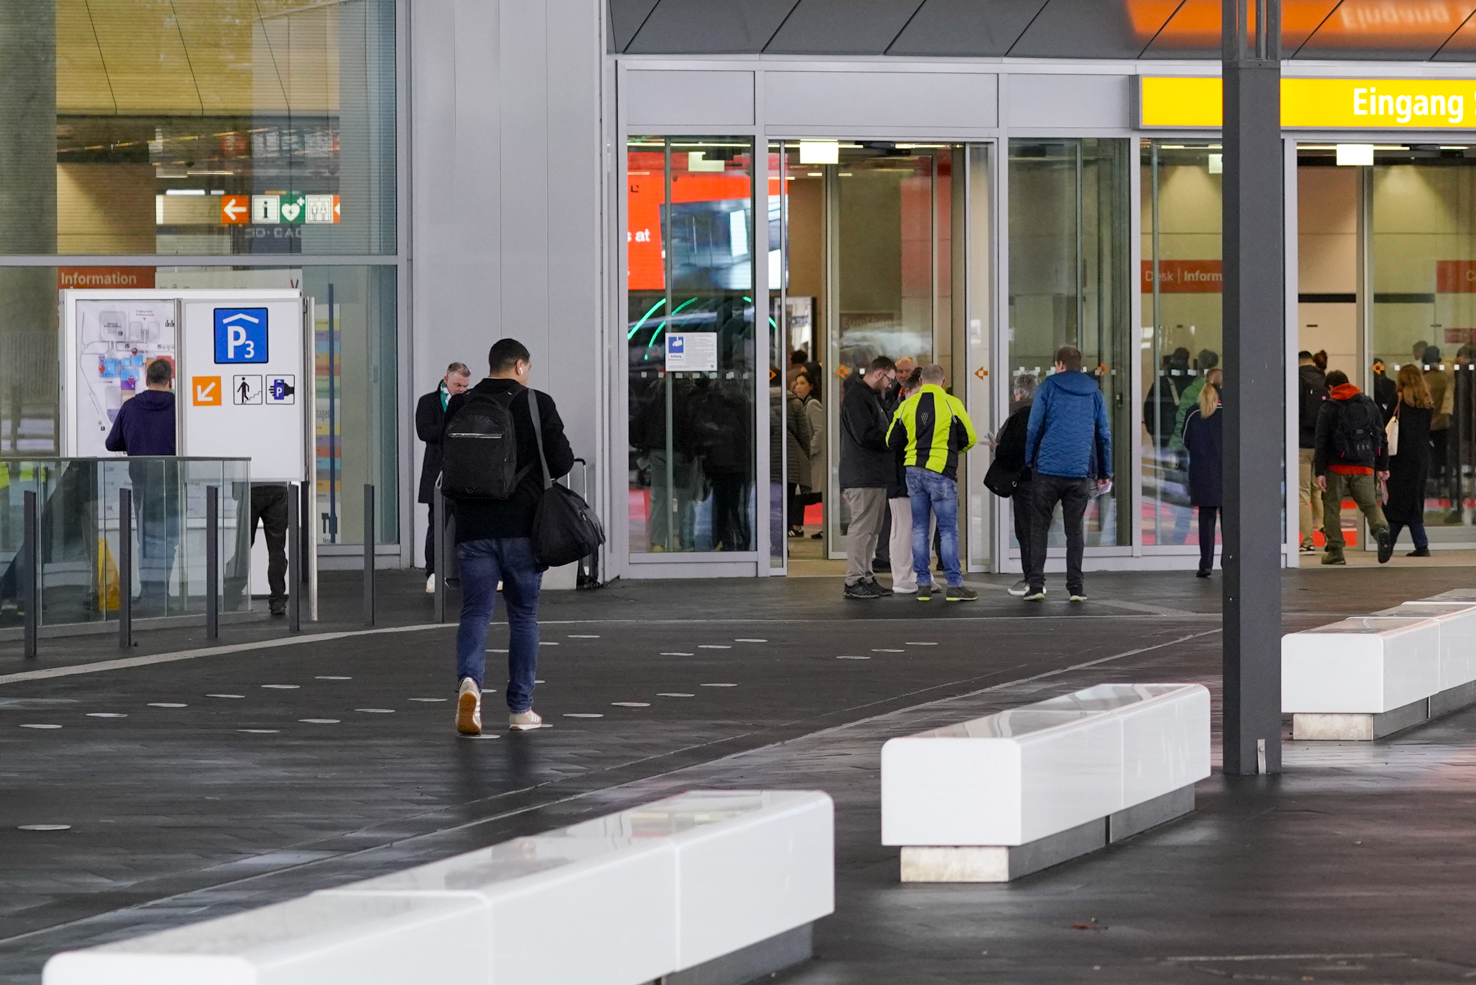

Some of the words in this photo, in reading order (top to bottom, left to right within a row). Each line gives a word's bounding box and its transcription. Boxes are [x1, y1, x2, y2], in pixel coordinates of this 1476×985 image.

[1353, 86, 1464, 124] Eingang
[635, 228, 651, 243] at
[61, 272, 137, 285] Information
[1145, 270, 1174, 282] Dsk
[1183, 270, 1223, 282] Inform
